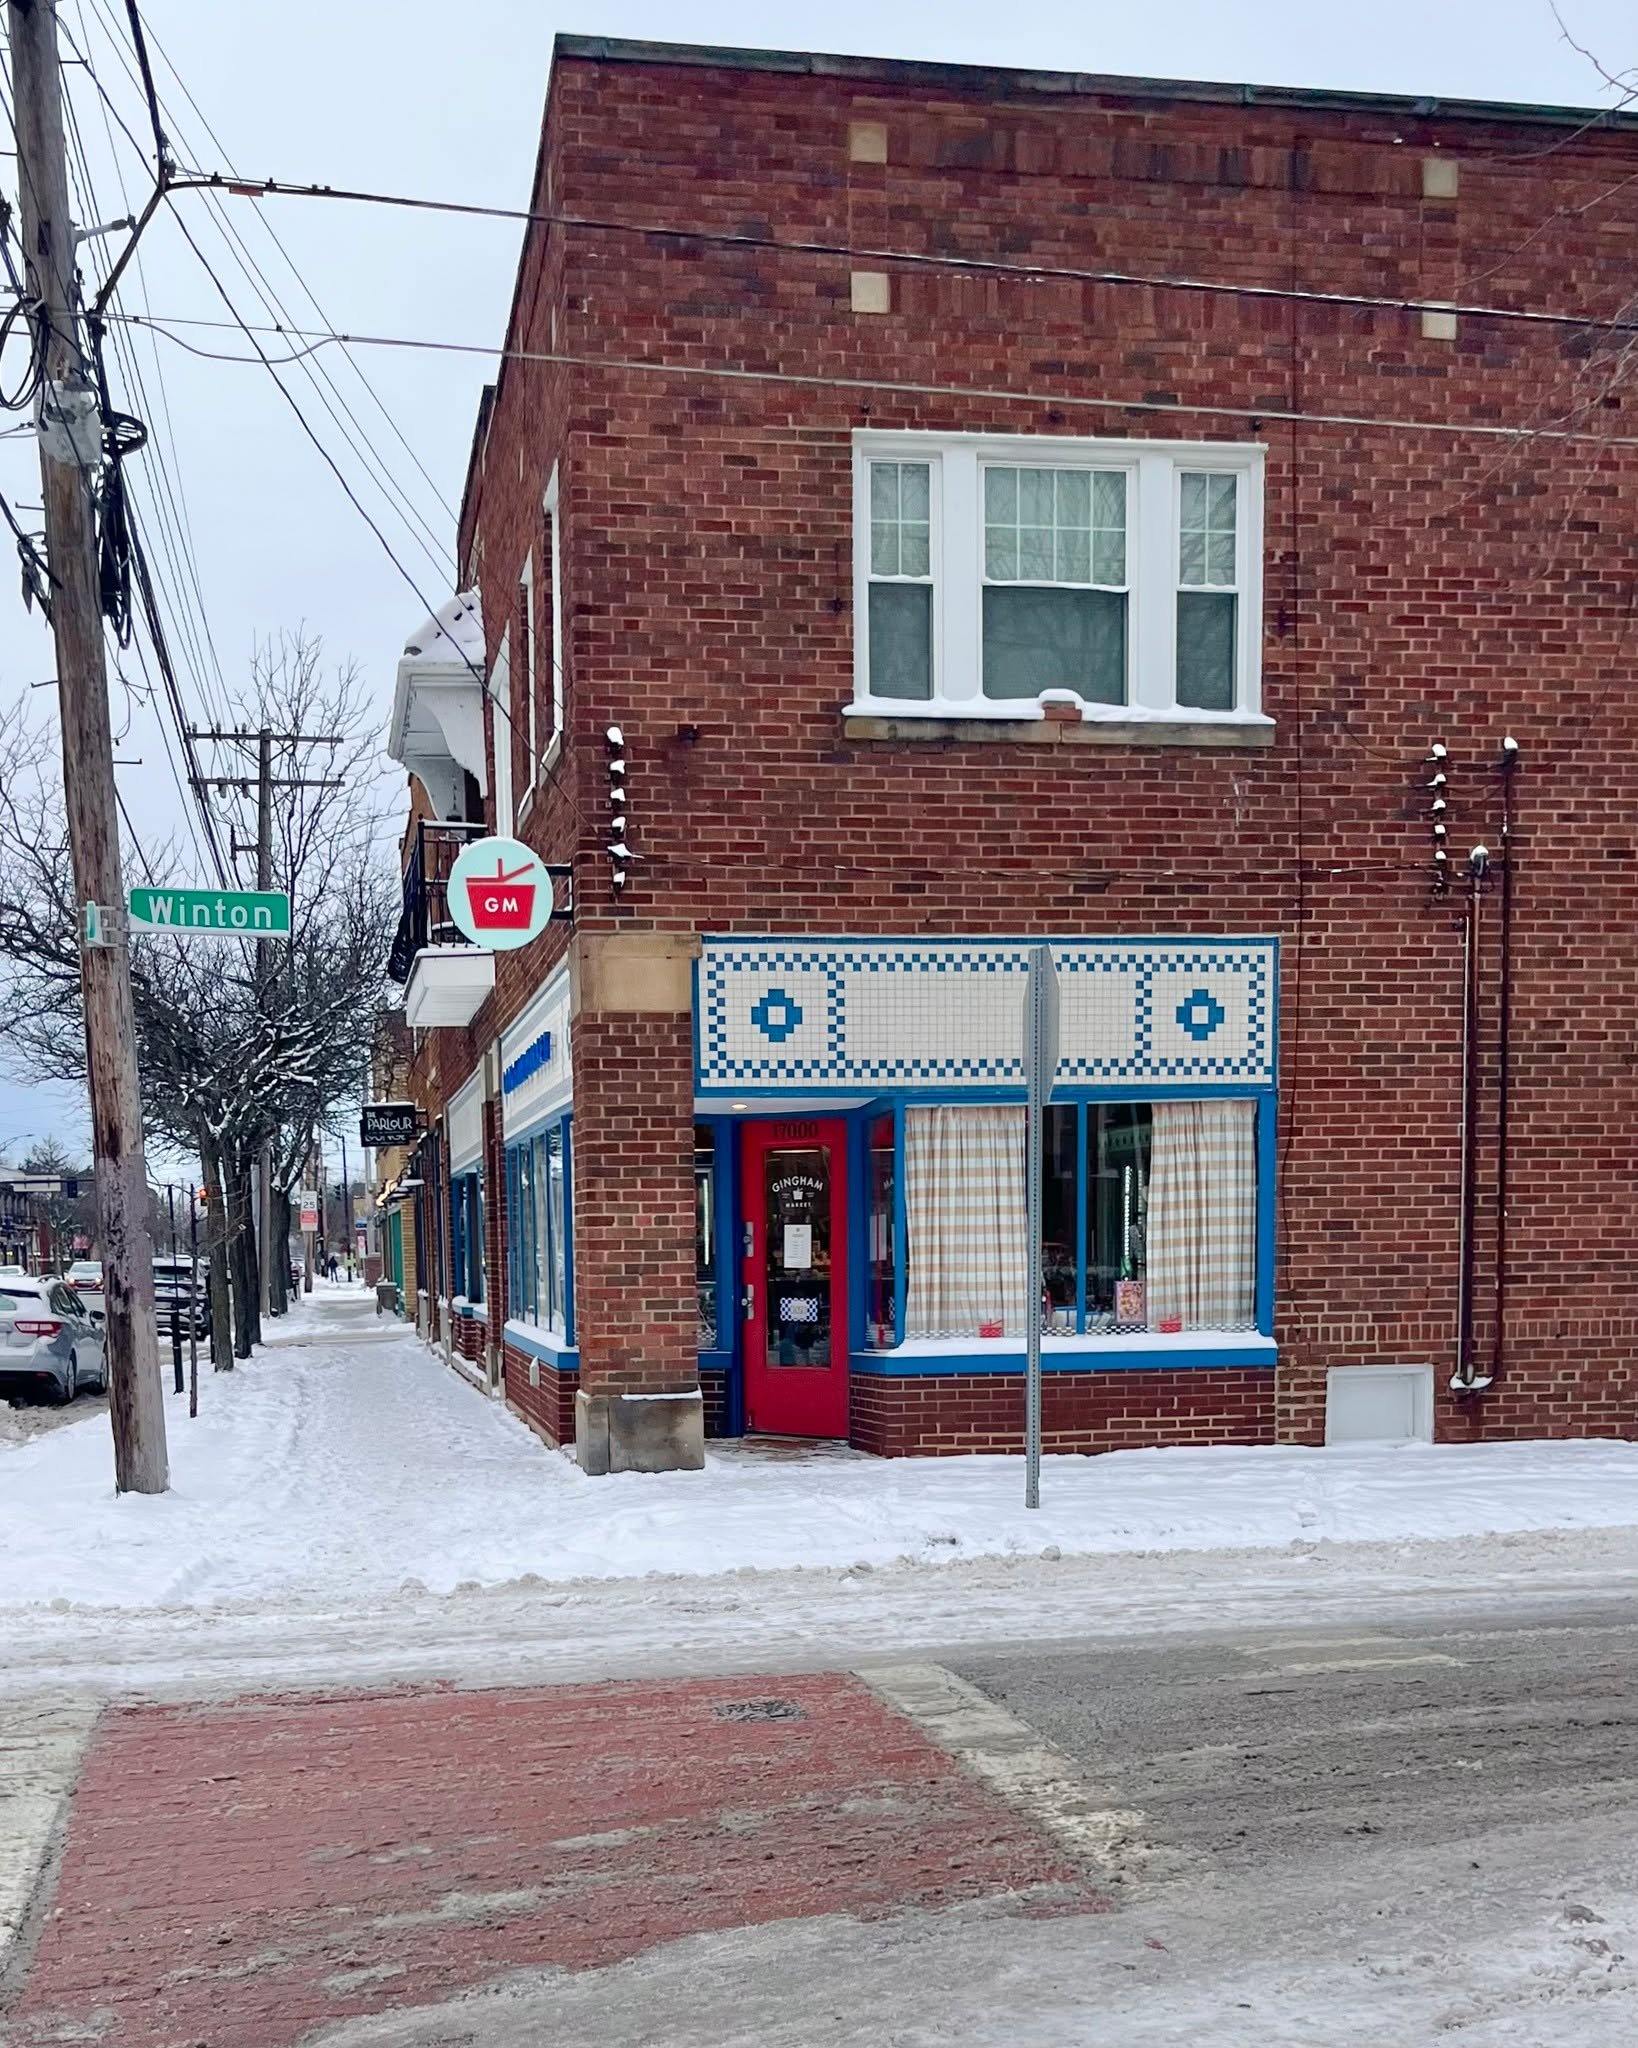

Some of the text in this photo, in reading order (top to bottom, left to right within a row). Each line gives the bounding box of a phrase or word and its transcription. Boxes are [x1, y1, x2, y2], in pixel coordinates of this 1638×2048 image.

[148, 895, 272, 929] Winton
[484, 896, 519, 913] GM
[367, 1117, 413, 1130] PARLOUR
[771, 1175, 823, 1192] GINGHAM
[303, 1201, 316, 1209] 25
